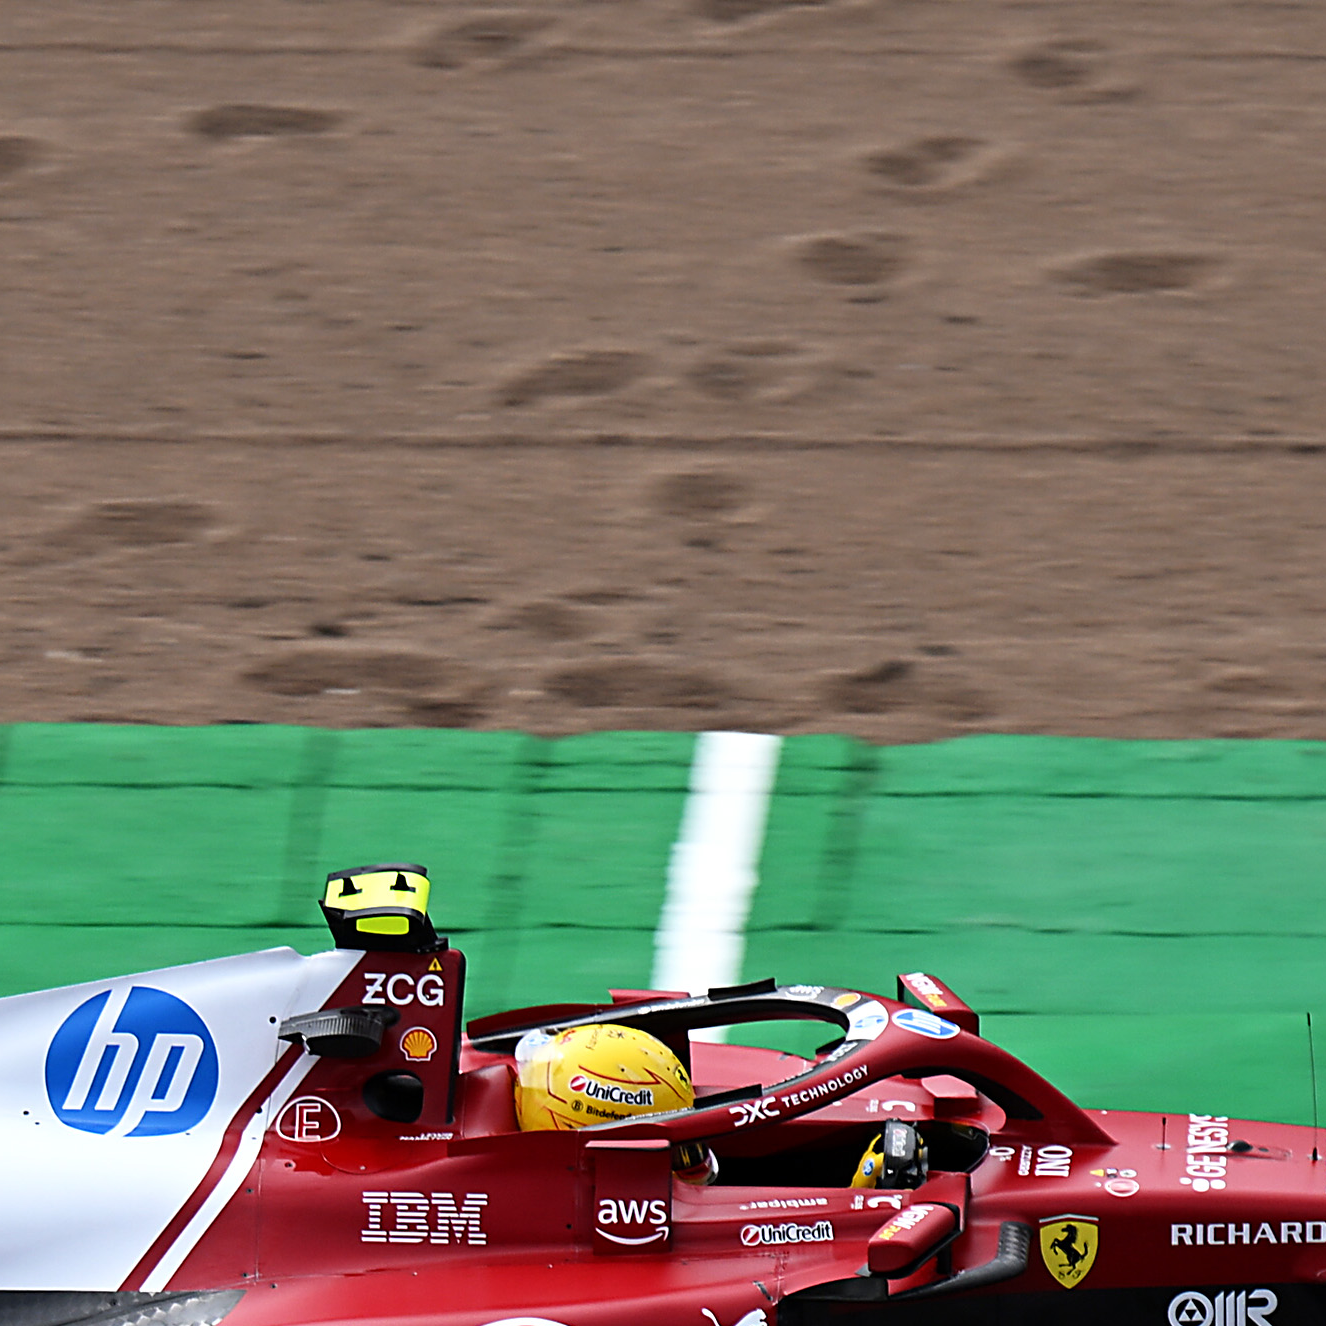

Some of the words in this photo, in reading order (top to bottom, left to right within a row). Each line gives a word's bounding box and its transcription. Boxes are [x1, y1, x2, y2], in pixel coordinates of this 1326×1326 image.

[62, 985, 205, 1137] hp
[585, 1079, 654, 1106] UniCredit
[729, 1097, 780, 1127] DXC
[782, 1064, 869, 1108] TECHNOLOGY
[361, 1191, 488, 1246] IBM
[598, 1199, 667, 1225] aws
[760, 1221, 833, 1244] UniCredit
